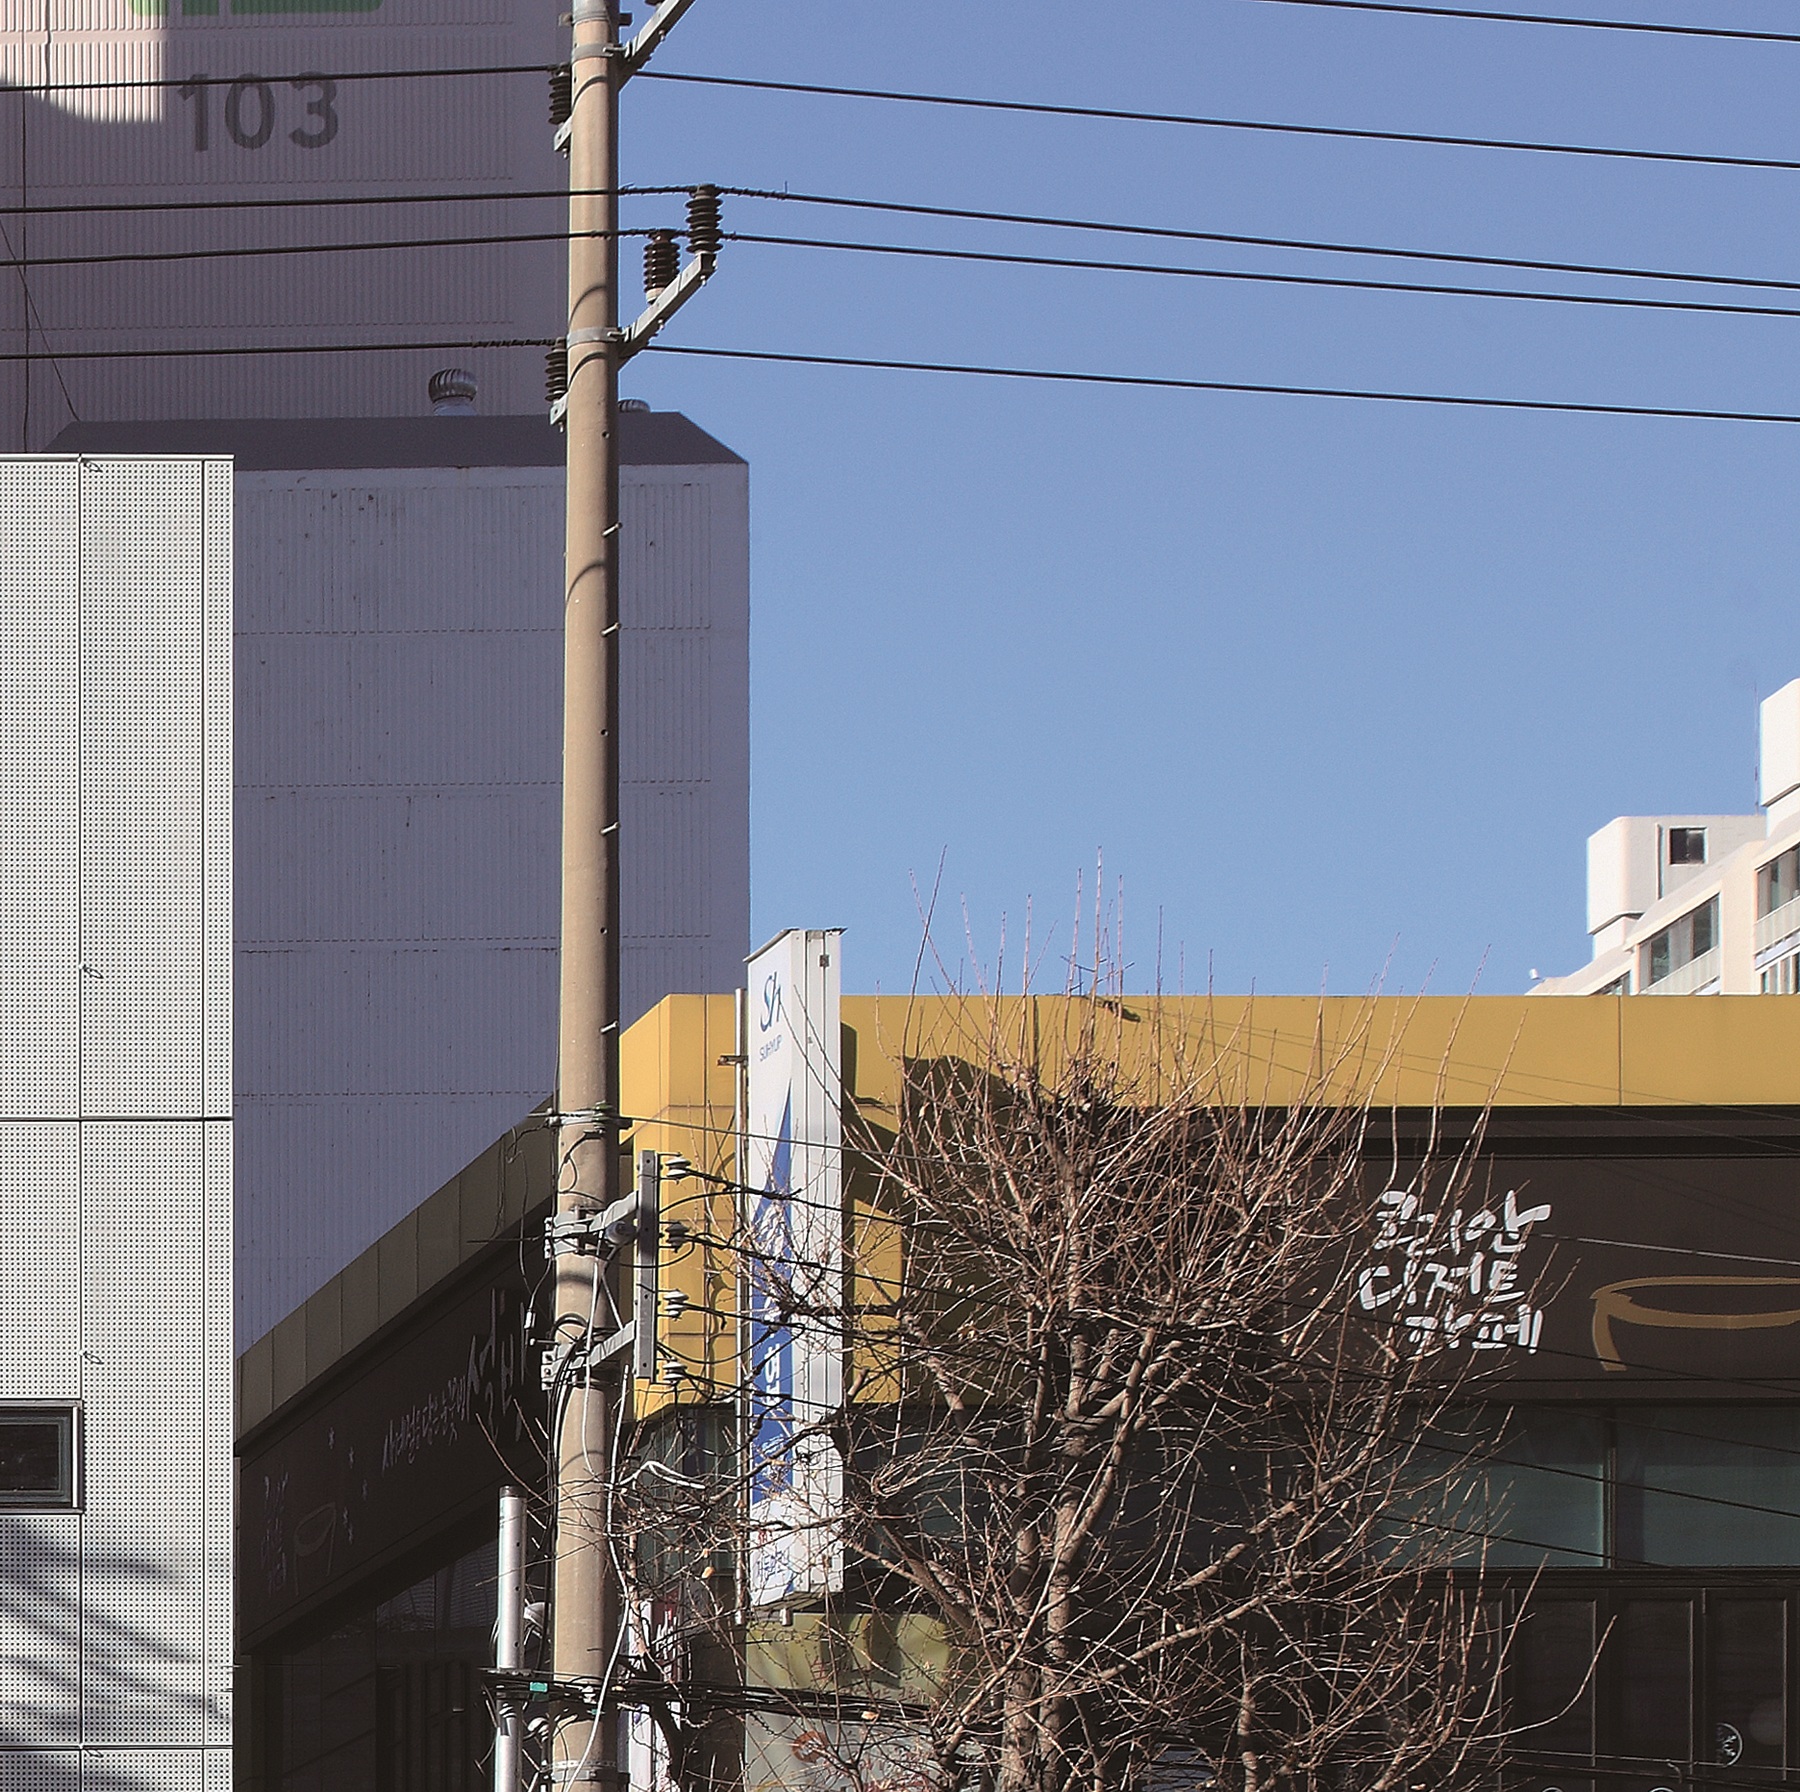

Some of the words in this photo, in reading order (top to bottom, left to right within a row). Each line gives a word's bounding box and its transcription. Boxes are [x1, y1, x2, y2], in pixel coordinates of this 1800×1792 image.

[179, 71, 339, 150] 103
[760, 971, 781, 1032] Sh
[1373, 1188, 1551, 1256] 코리안
[1358, 1252, 1525, 1311] 디저트
[1406, 1303, 1543, 1355] 카페
